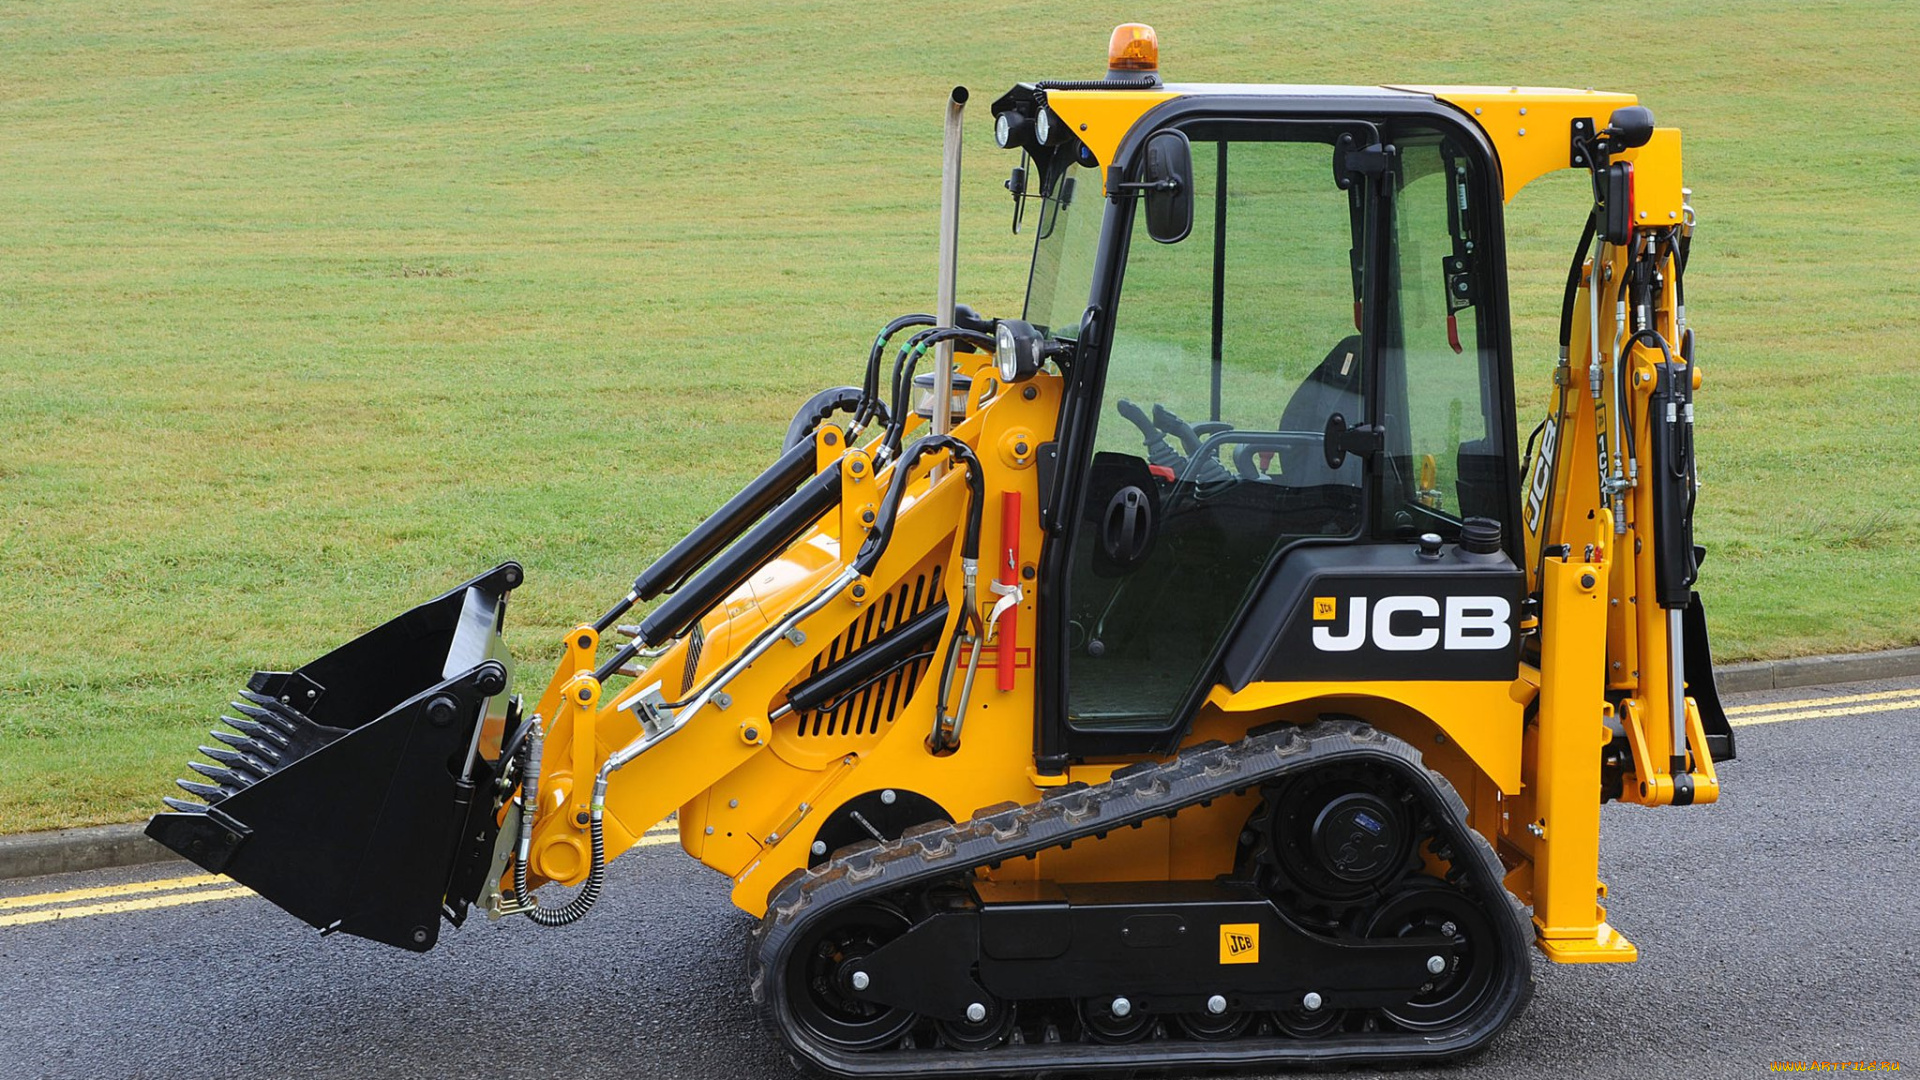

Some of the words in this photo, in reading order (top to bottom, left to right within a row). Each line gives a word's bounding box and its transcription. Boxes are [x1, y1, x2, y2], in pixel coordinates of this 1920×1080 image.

[1530, 420, 1557, 531] JCB
[1312, 596, 1511, 651] JCB
[1230, 935, 1252, 953] JCB
